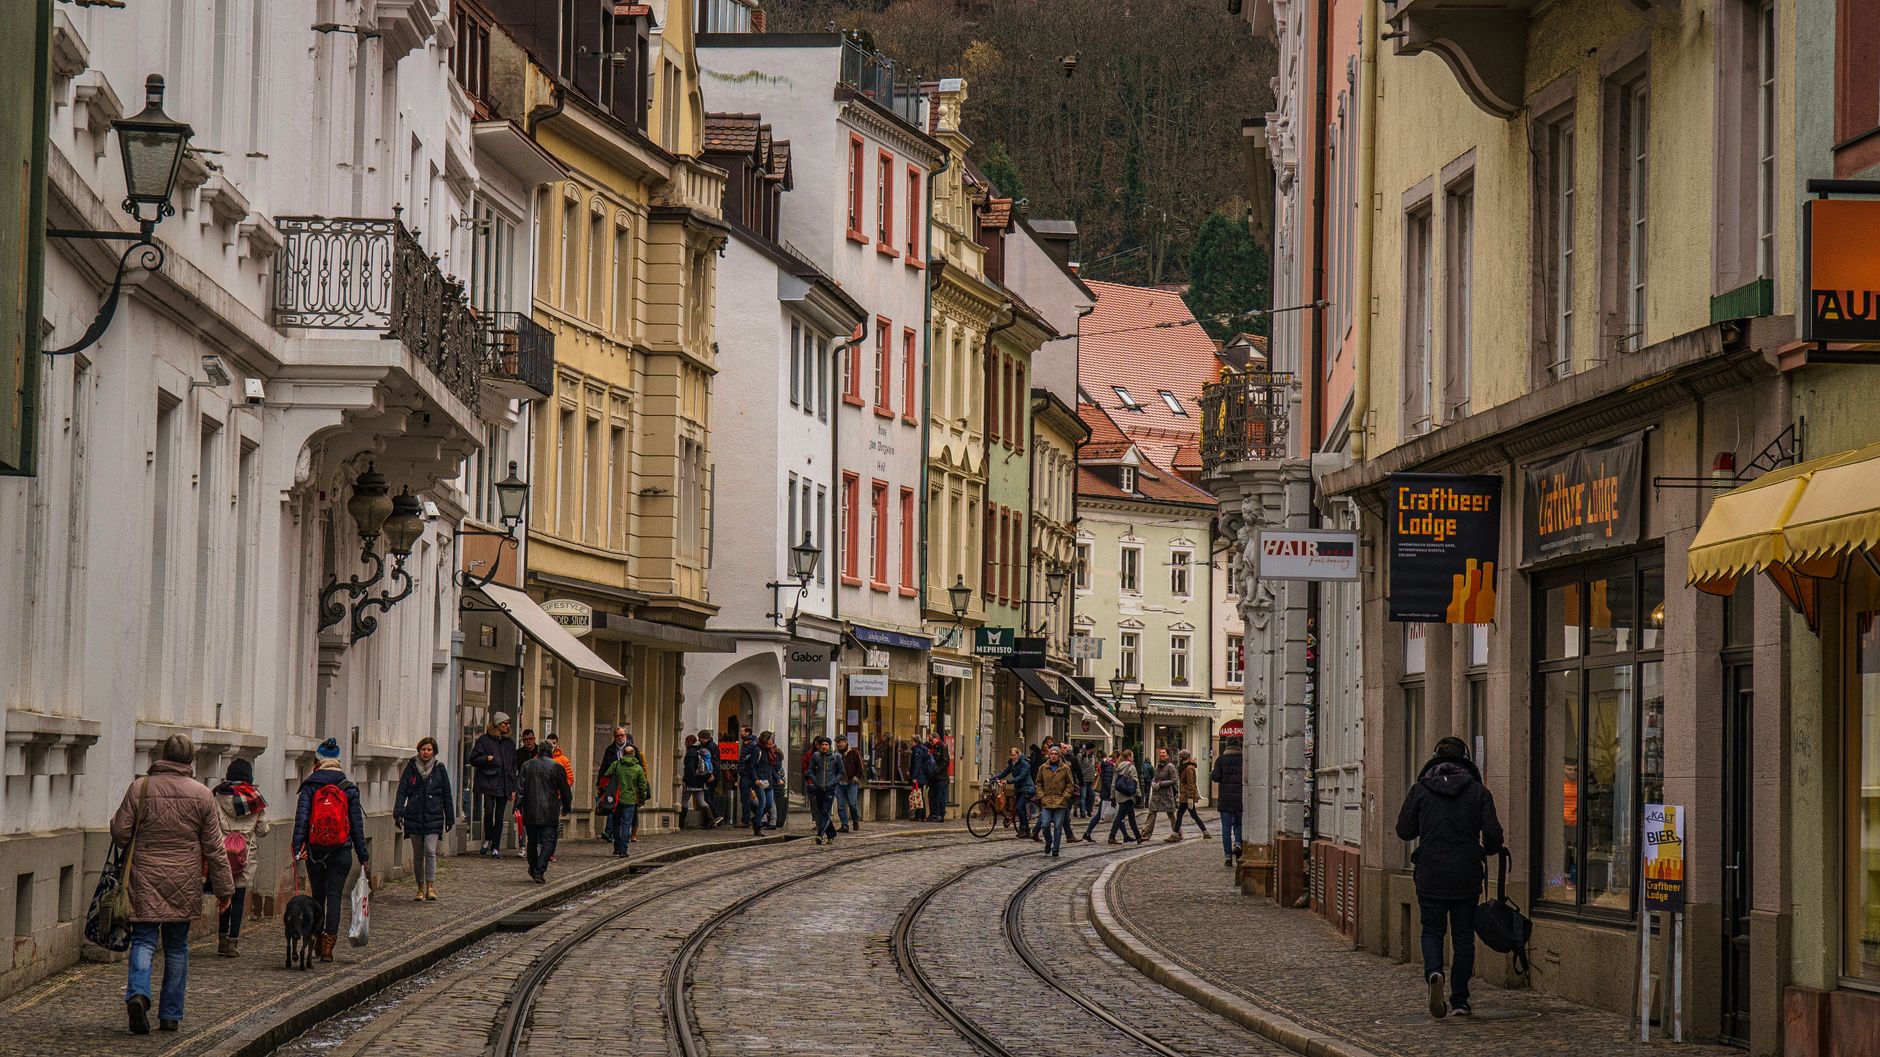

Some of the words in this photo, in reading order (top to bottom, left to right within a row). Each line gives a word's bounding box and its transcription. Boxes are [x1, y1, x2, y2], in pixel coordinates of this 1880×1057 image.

[1398, 487, 1492, 511] Craftbeer
[1398, 512, 1457, 541] Lodge
[1264, 540, 1319, 556] HAIR
[542, 602, 585, 612] LIFESTYLE
[976, 645, 1012, 654] MEPHISTO
[791, 651, 823, 662] Gabor
[721, 747, 737, 755] 50%
[1651, 810, 1675, 821] KALT
[1646, 829, 1674, 843] BIER
[1646, 881, 1681, 892] Craftbeer
[1646, 890, 1669, 902] Lodge
